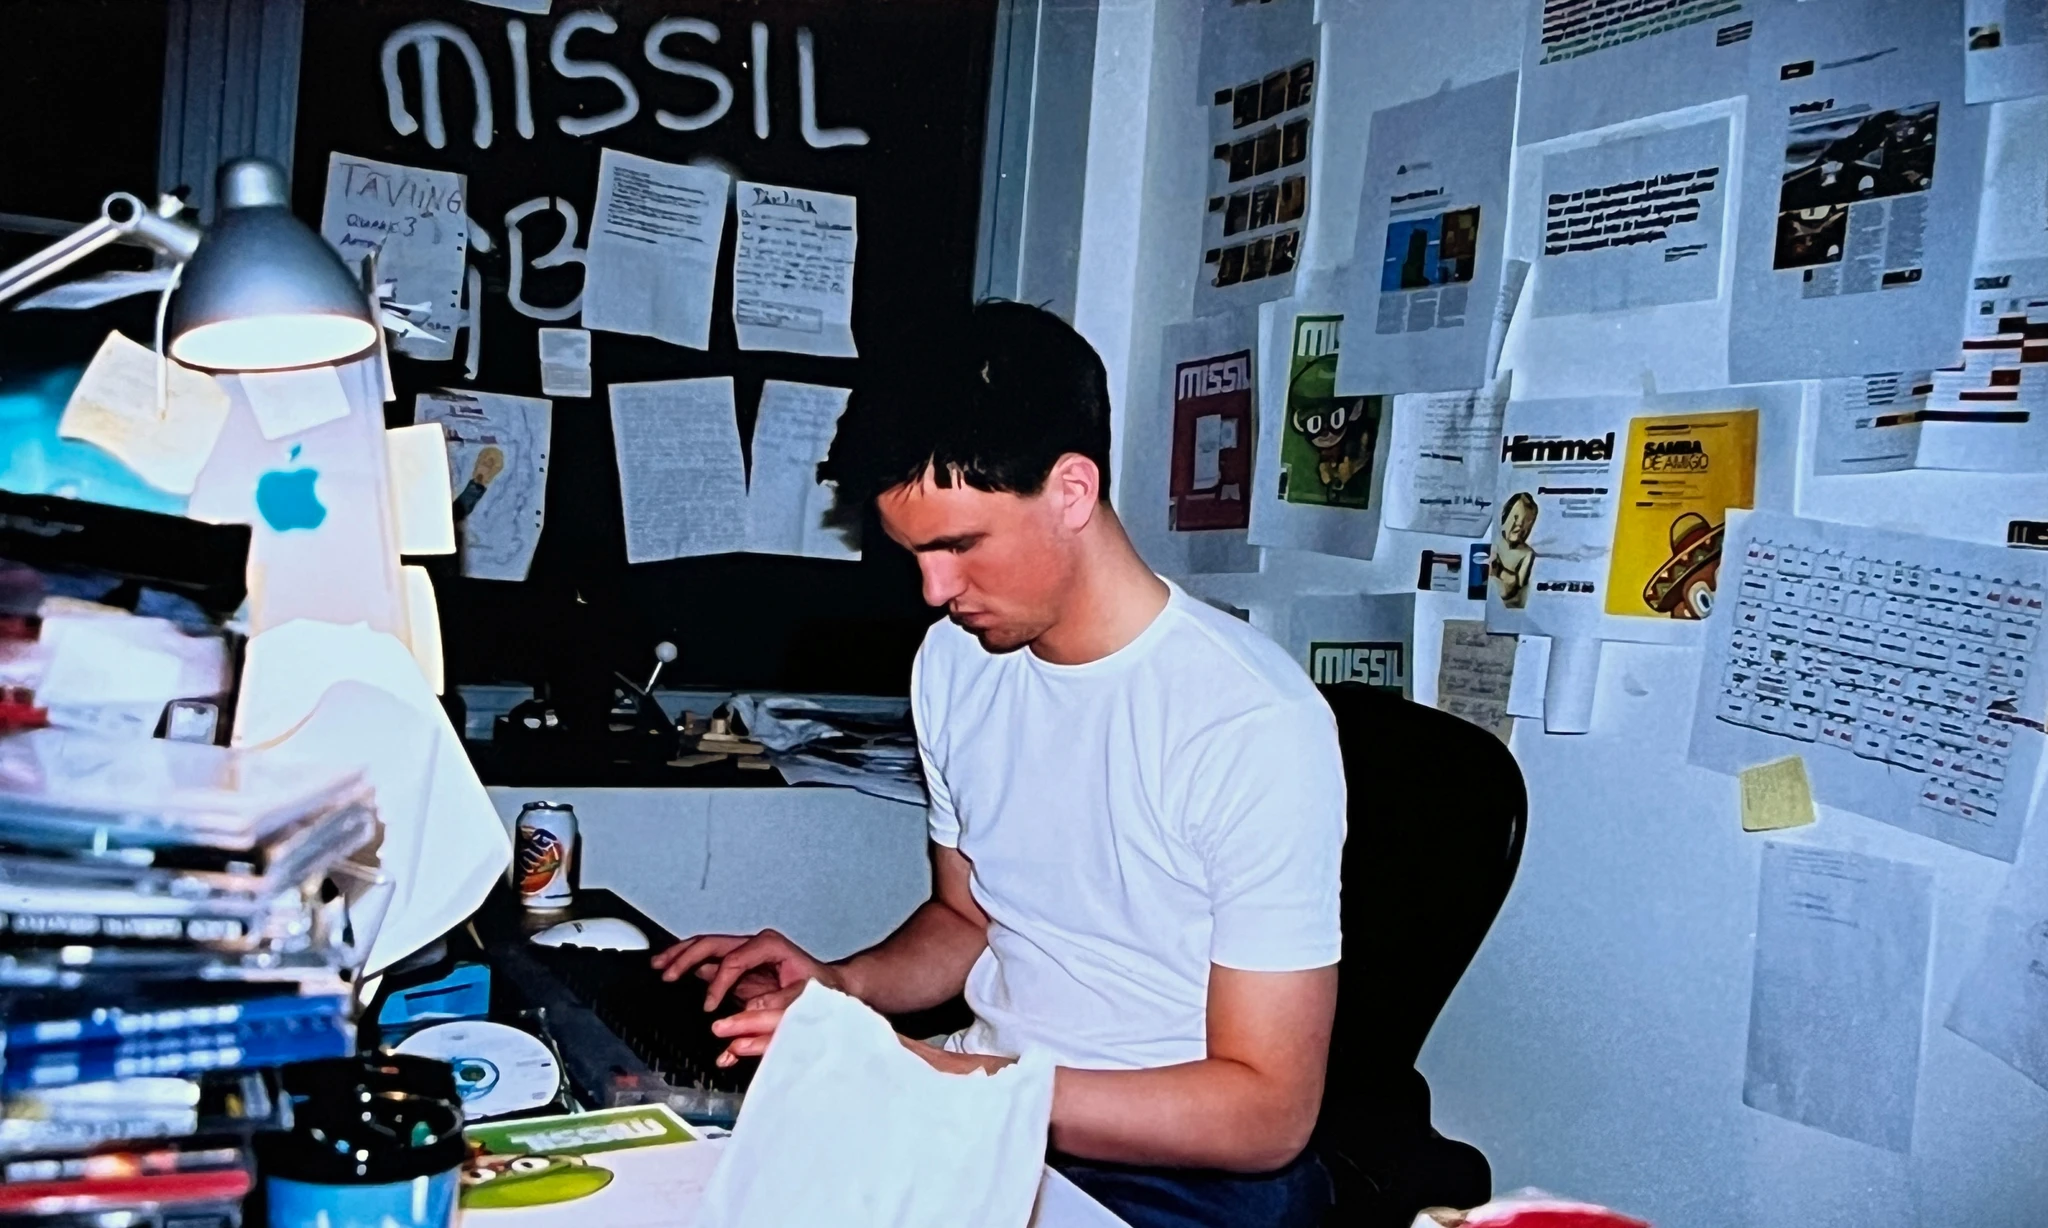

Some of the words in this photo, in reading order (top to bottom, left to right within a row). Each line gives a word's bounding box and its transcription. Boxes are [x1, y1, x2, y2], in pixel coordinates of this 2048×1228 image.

[381, 10, 870, 148] MISSIL
[1178, 356, 1250, 401] MISSIL
[1314, 648, 1403, 686] MISSIL
